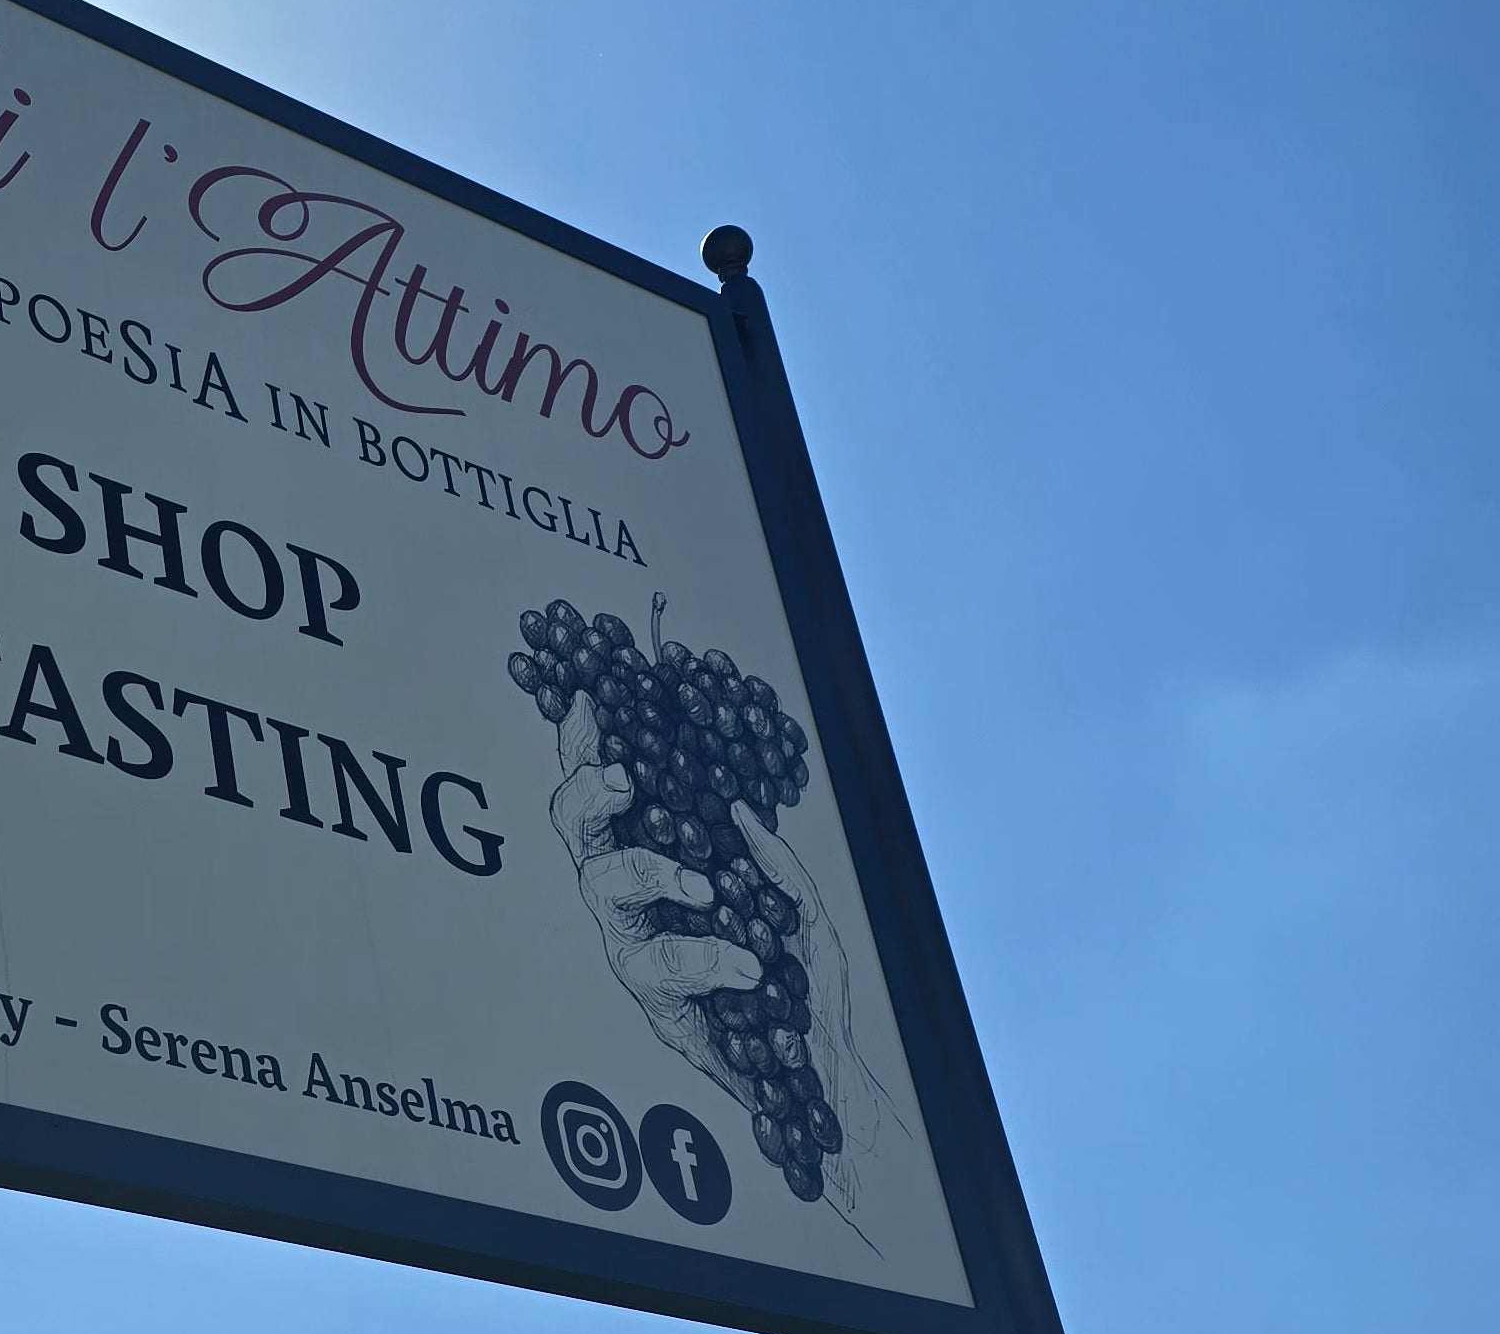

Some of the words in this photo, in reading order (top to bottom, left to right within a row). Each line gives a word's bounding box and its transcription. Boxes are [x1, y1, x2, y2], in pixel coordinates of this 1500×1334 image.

[17, 451, 362, 648] SHOP
[264, 382, 332, 449] IN
[352, 415, 649, 568] BOTTIGLIA
[100, 1002, 289, 1093] Serena
[301, 1051, 522, 1147] Anselma
